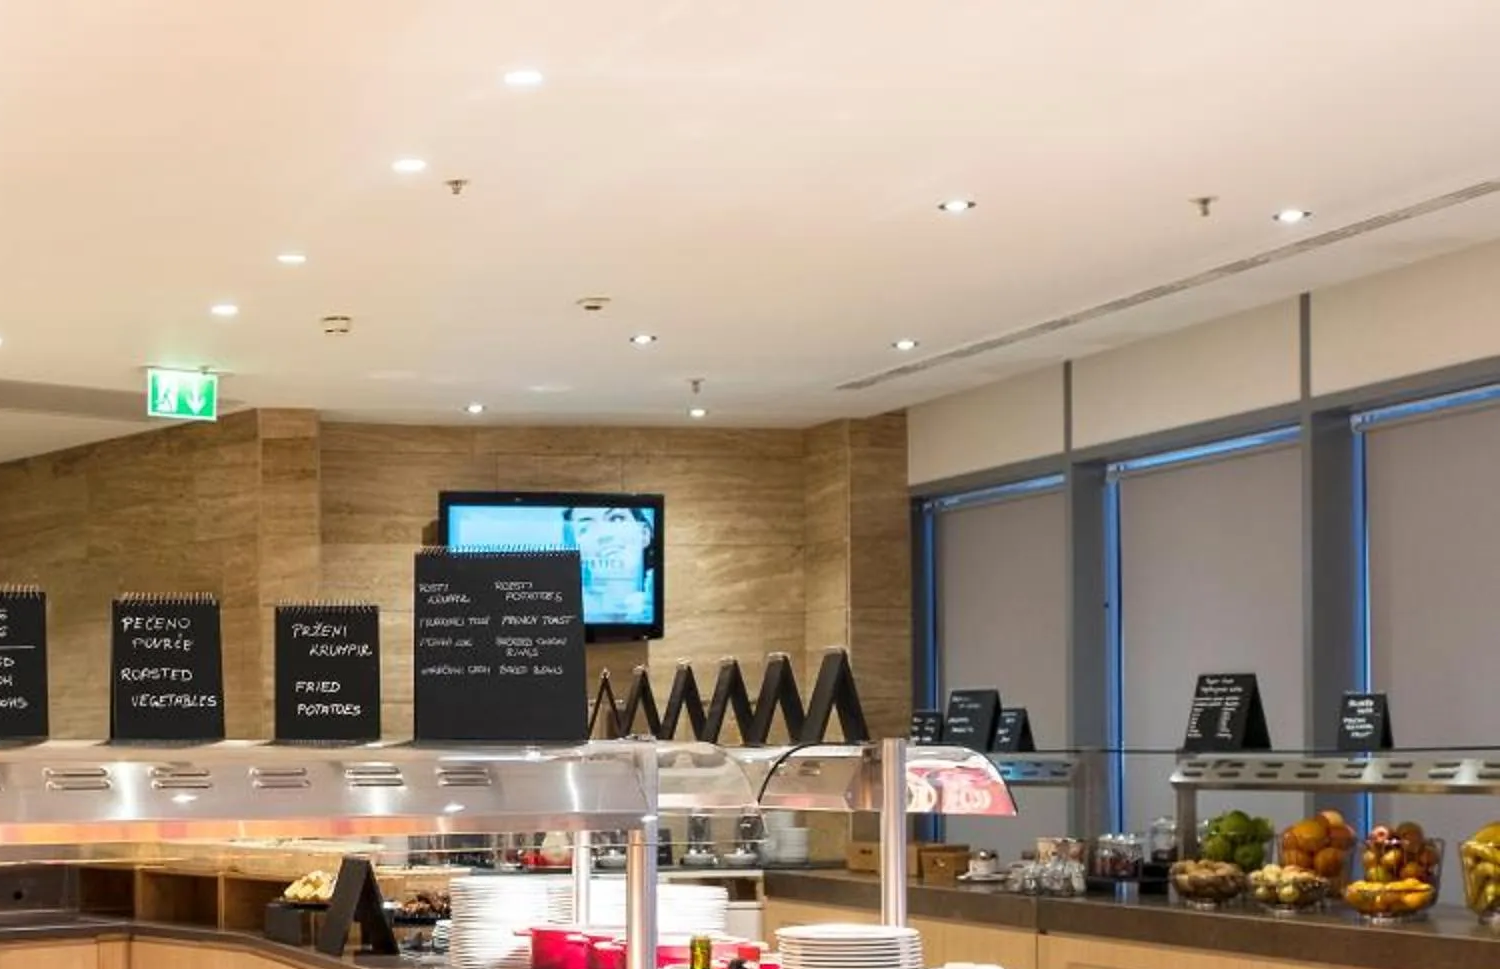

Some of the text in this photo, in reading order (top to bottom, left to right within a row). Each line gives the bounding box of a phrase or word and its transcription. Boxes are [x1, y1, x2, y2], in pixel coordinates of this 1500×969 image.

[121, 616, 190, 632] PEČENO
[121, 668, 192, 681] ROASTED
[296, 681, 340, 693] FRIED
[132, 694, 217, 708] VEGETABLES
[297, 704, 361, 716] POTATOES
